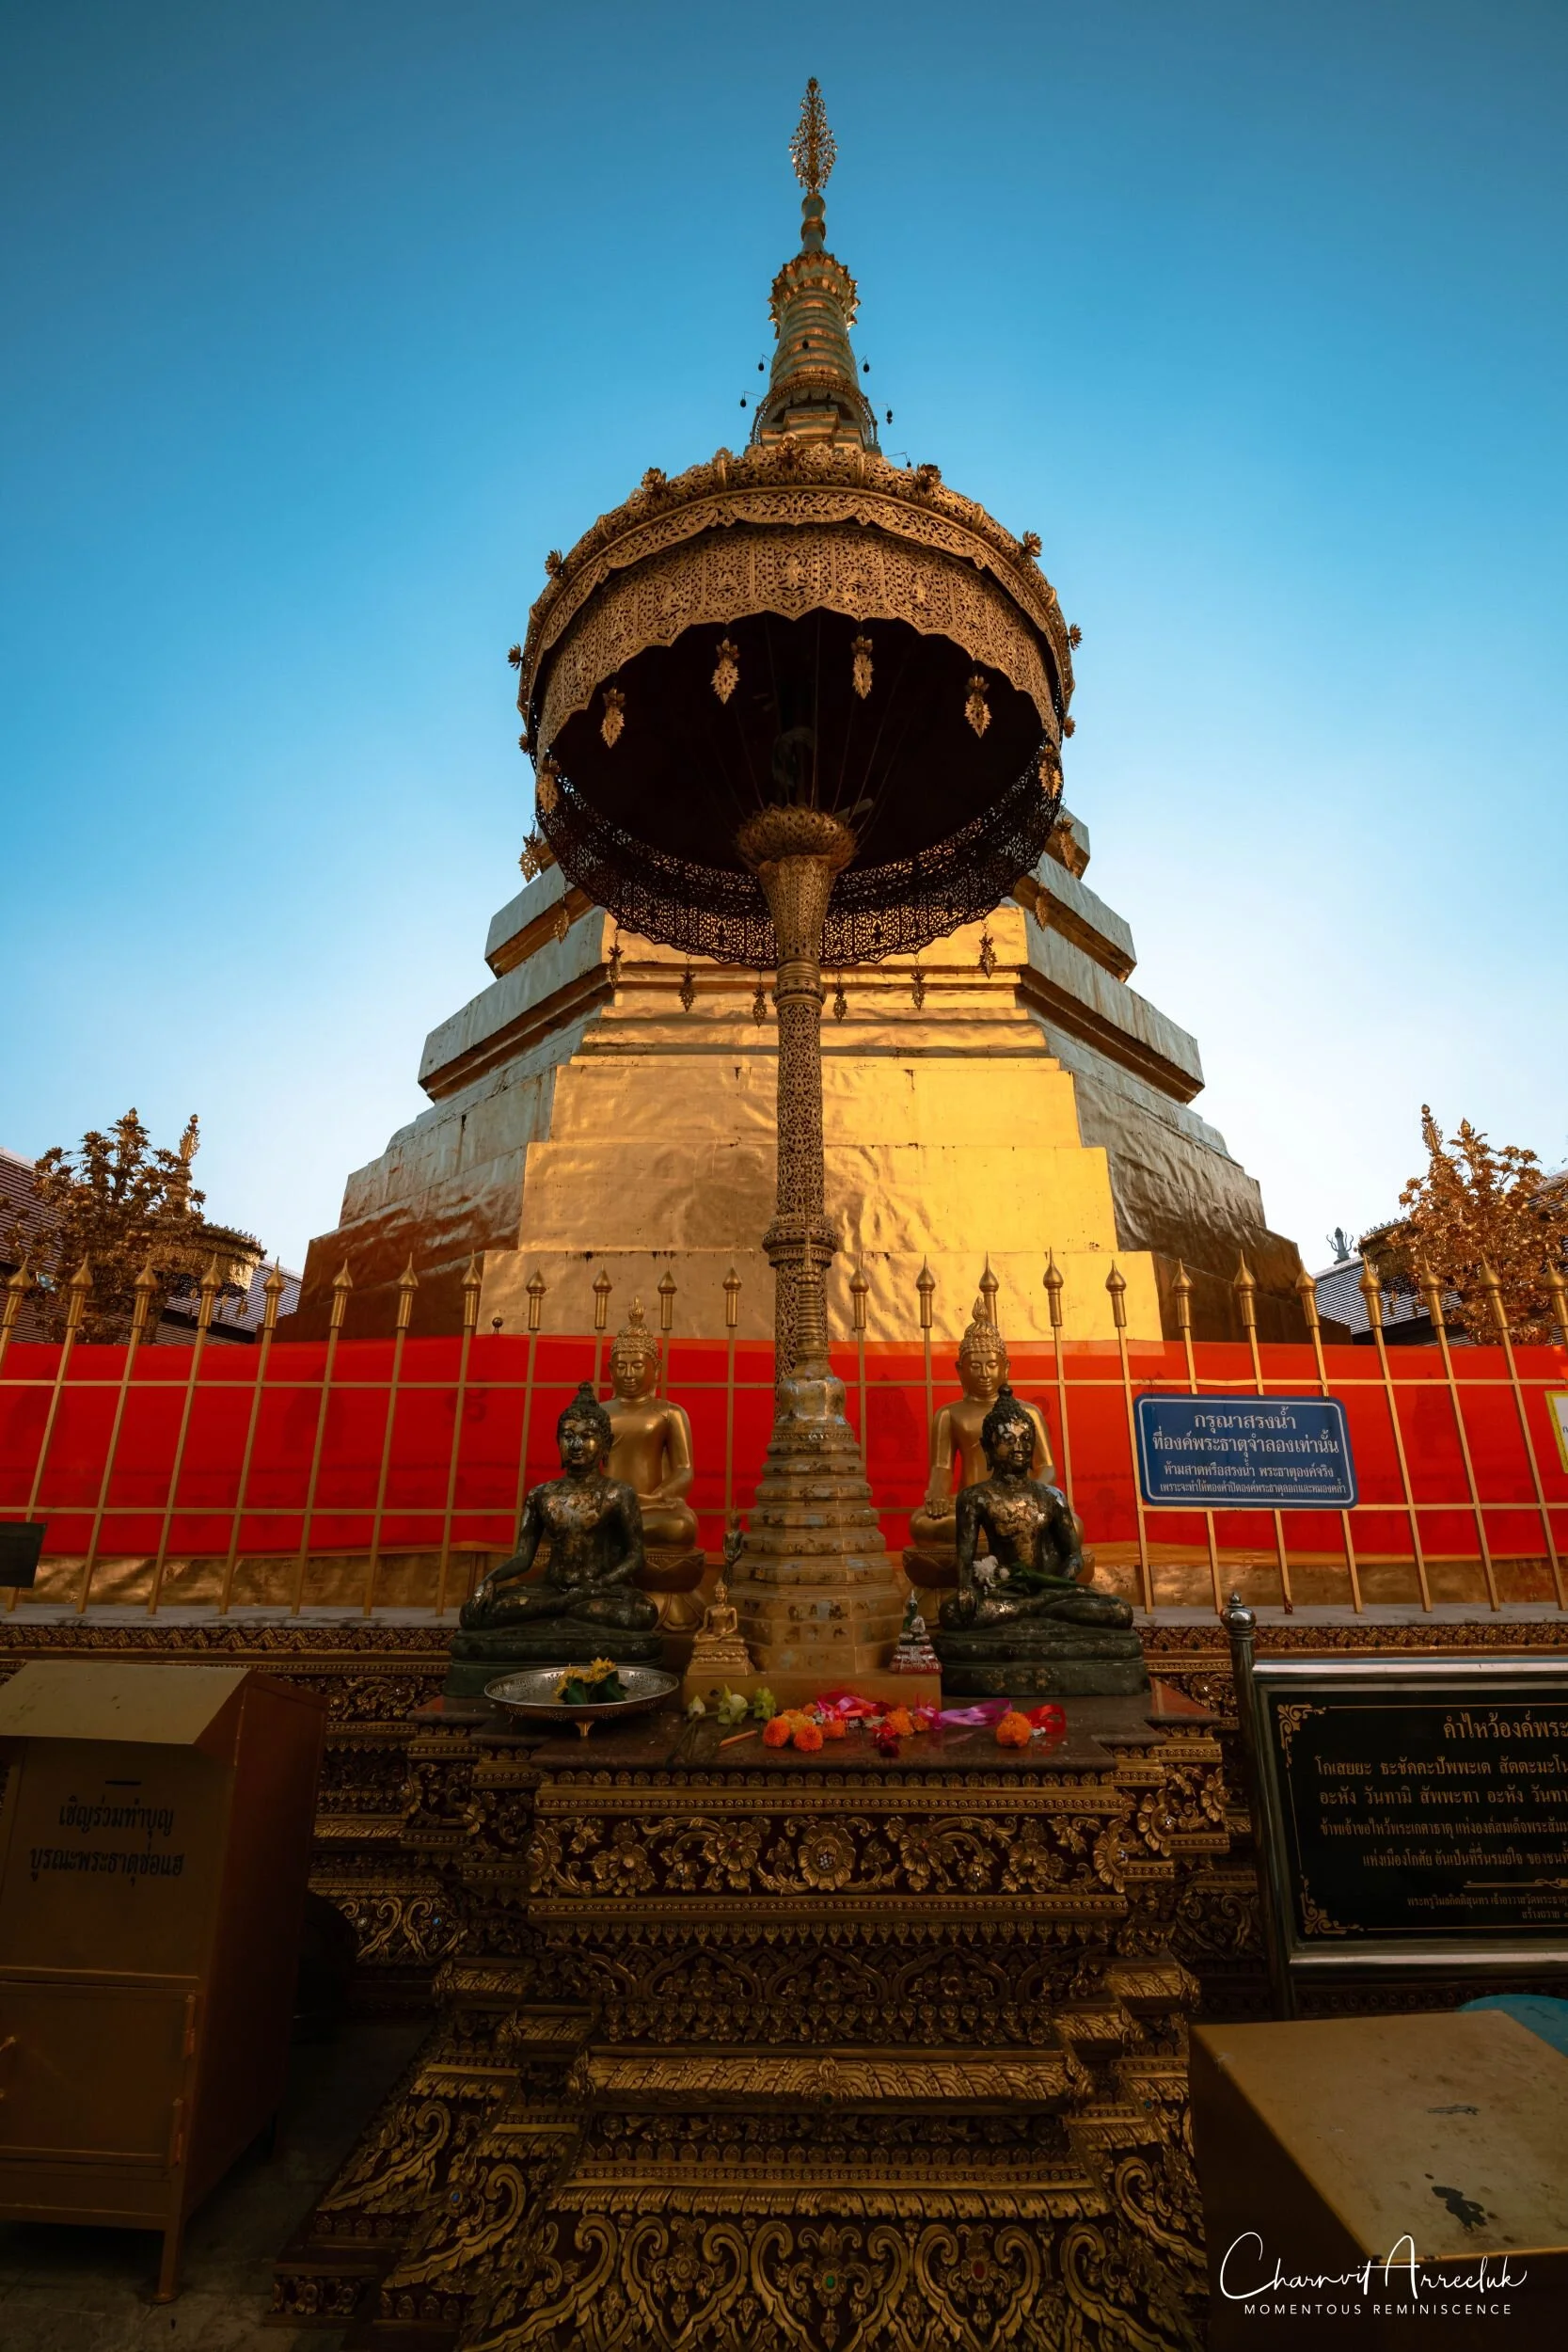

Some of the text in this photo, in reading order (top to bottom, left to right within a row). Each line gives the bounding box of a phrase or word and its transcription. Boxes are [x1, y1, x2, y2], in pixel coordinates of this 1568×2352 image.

[1194, 1406, 1297, 1434] กรุณาสรงน้ำ
[1152, 1425, 1339, 1457] ที่องค์พระธาตุจำลองเท่านั้น
[1164, 1458, 1334, 1482] ห้ามสาดหรือสรงน้ำ พระธาตุองค์จริง
[1313, 1755, 1372, 1776] โกเสยยะ
[1319, 1784, 1568, 1804] อะหัง วันทามิ สัพพะทา อะหัง วันทา
[59, 1794, 174, 1839] เชิญร่วมทำบุญ
[30, 1843, 185, 1887] บูรณะพระธาตุช่อแฮ
